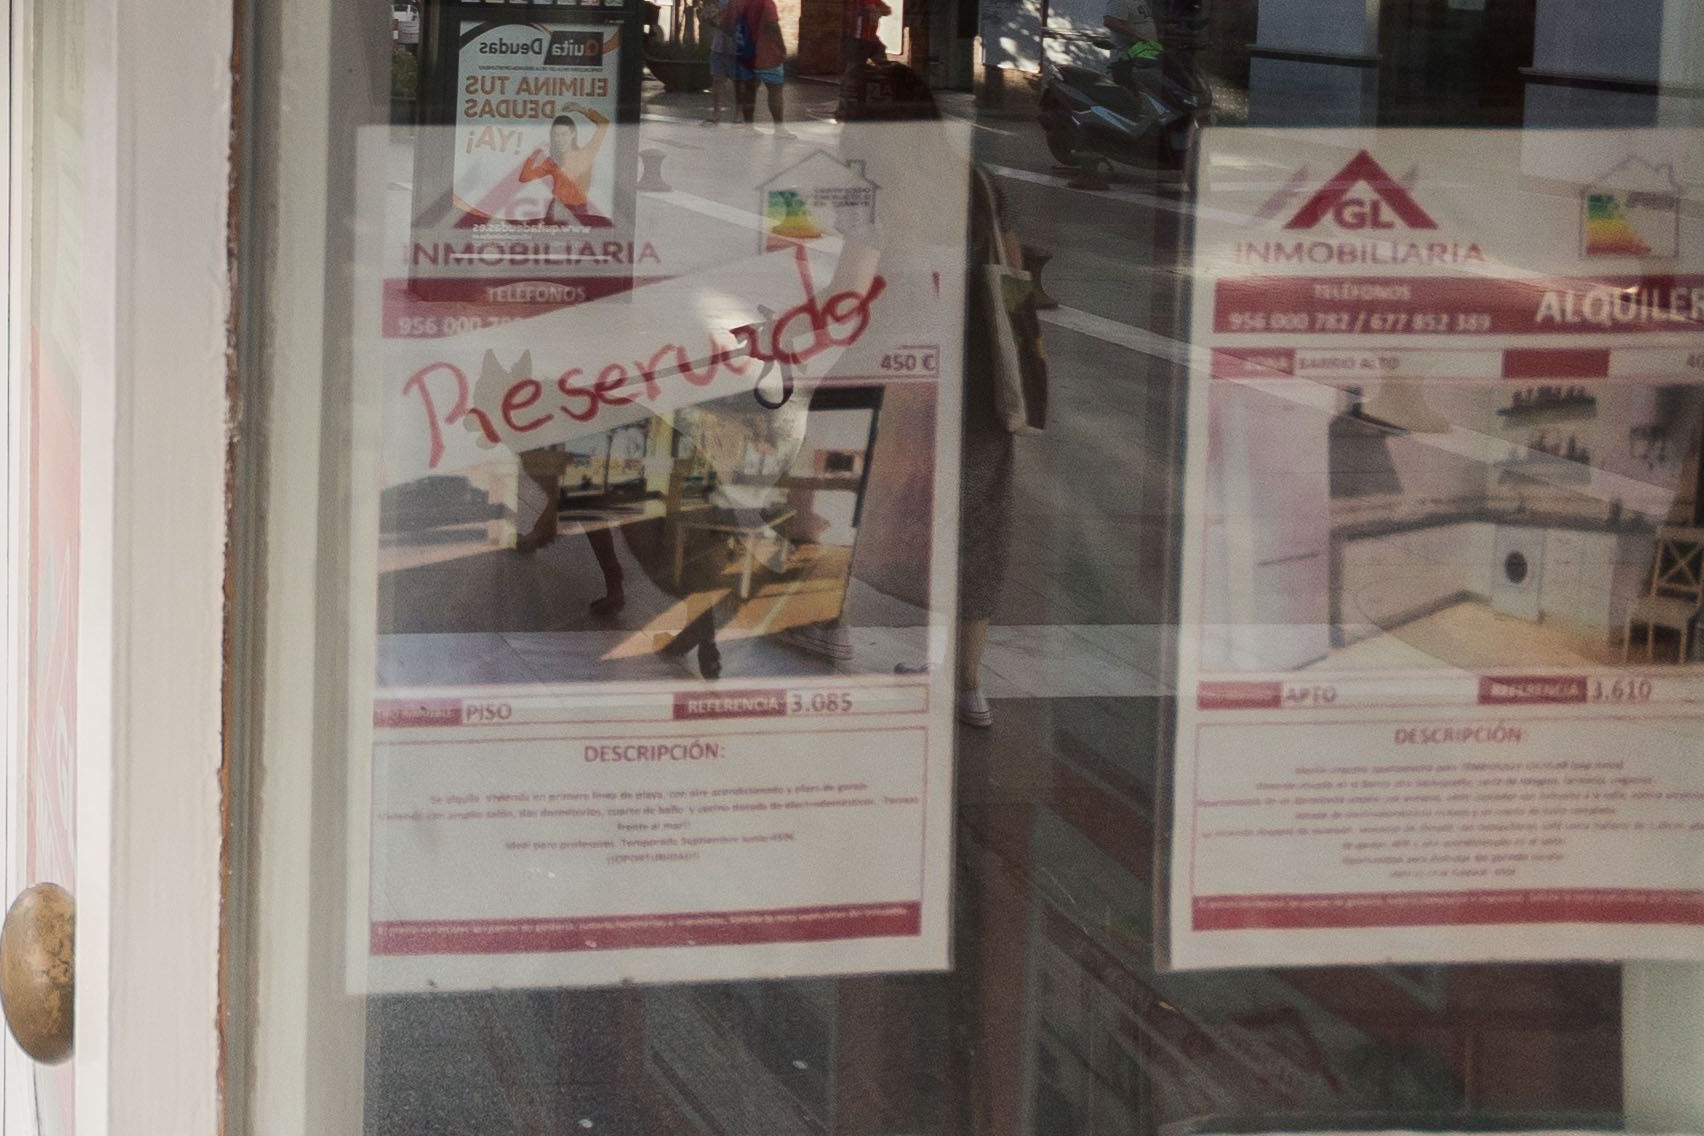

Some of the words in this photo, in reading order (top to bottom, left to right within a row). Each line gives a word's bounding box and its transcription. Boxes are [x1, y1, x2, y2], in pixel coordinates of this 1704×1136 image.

[1332, 197, 1395, 231] GL
[402, 241, 662, 266] INMOBILIARIA
[1235, 241, 1490, 264] INMOBILIARIA
[398, 316, 438, 336] 956
[1229, 312, 1265, 331] 956
[1369, 312, 1410, 331] 677
[880, 354, 917, 371] 450
[465, 702, 513, 721] PISO
[790, 692, 854, 714] 3.085
[583, 737, 727, 764] DESCRIPCIÓN:
